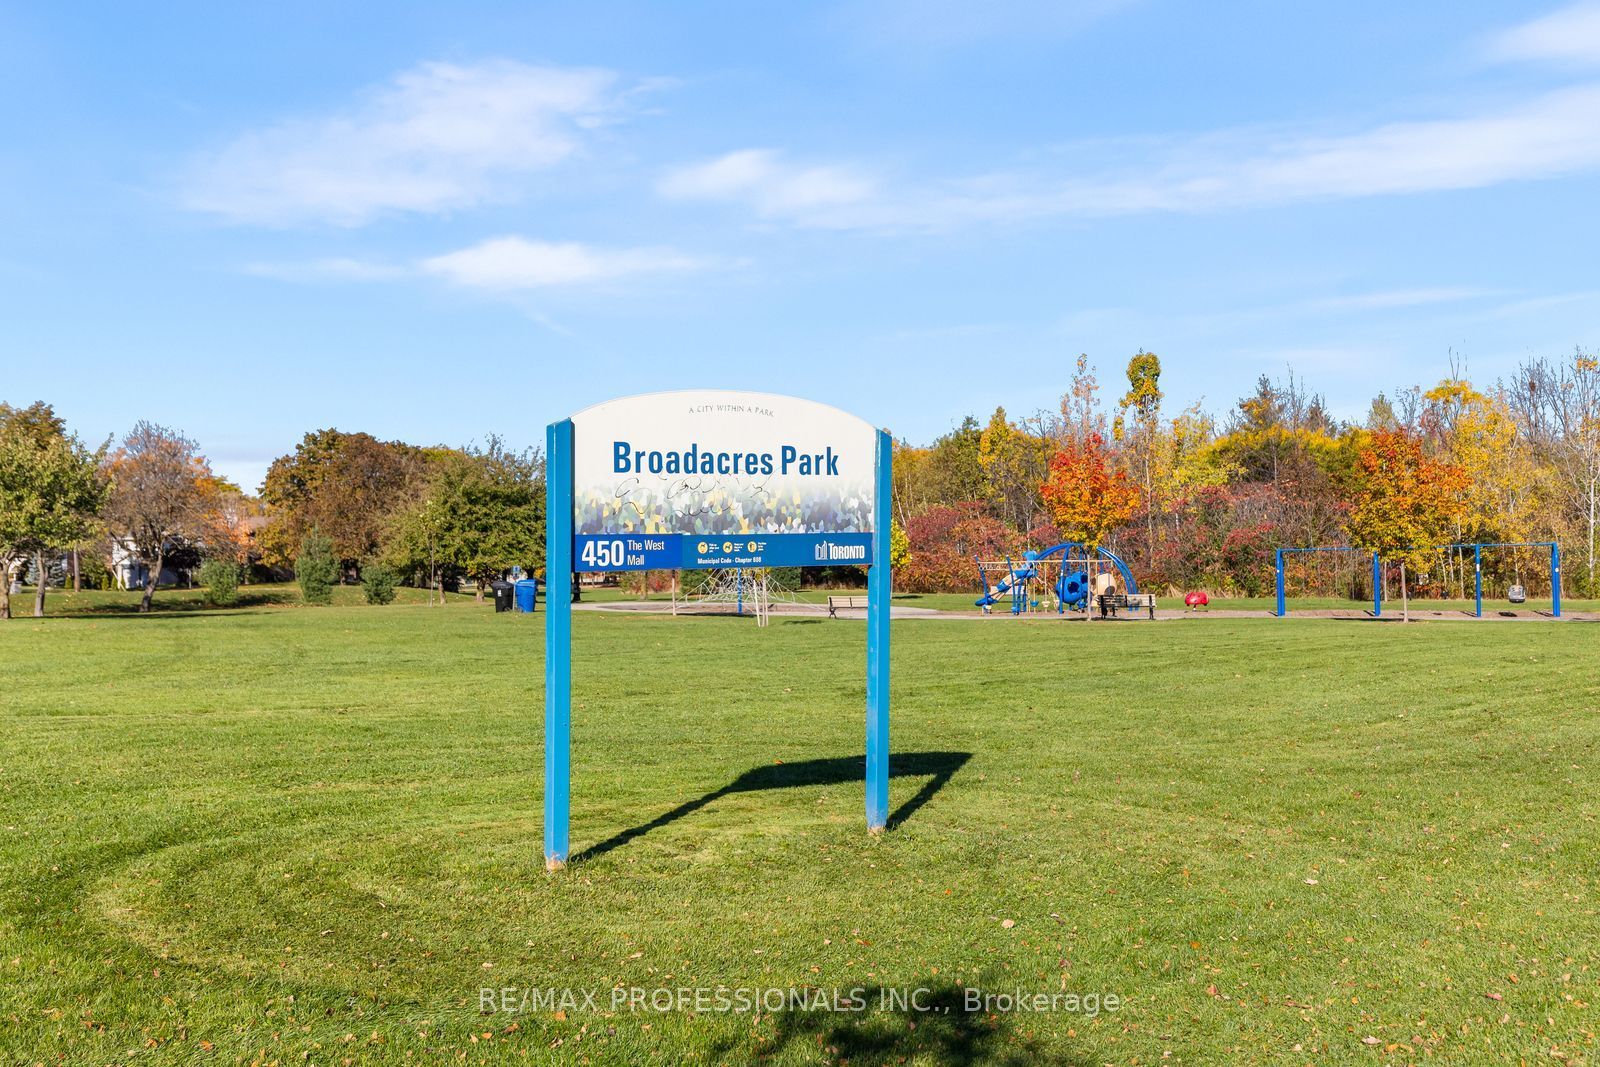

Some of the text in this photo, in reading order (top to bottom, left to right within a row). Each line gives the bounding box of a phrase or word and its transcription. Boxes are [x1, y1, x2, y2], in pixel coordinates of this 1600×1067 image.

[697, 405, 714, 413] CITY
[717, 404, 744, 412] WITHIN
[755, 407, 775, 417] PARK
[613, 441, 839, 476] Broadacres Park
[627, 539, 664, 551] The West
[828, 543, 865, 560] TORONTO
[581, 540, 625, 567] 450
[735, 556, 752, 564] Chapter
[627, 555, 644, 566] Mall
